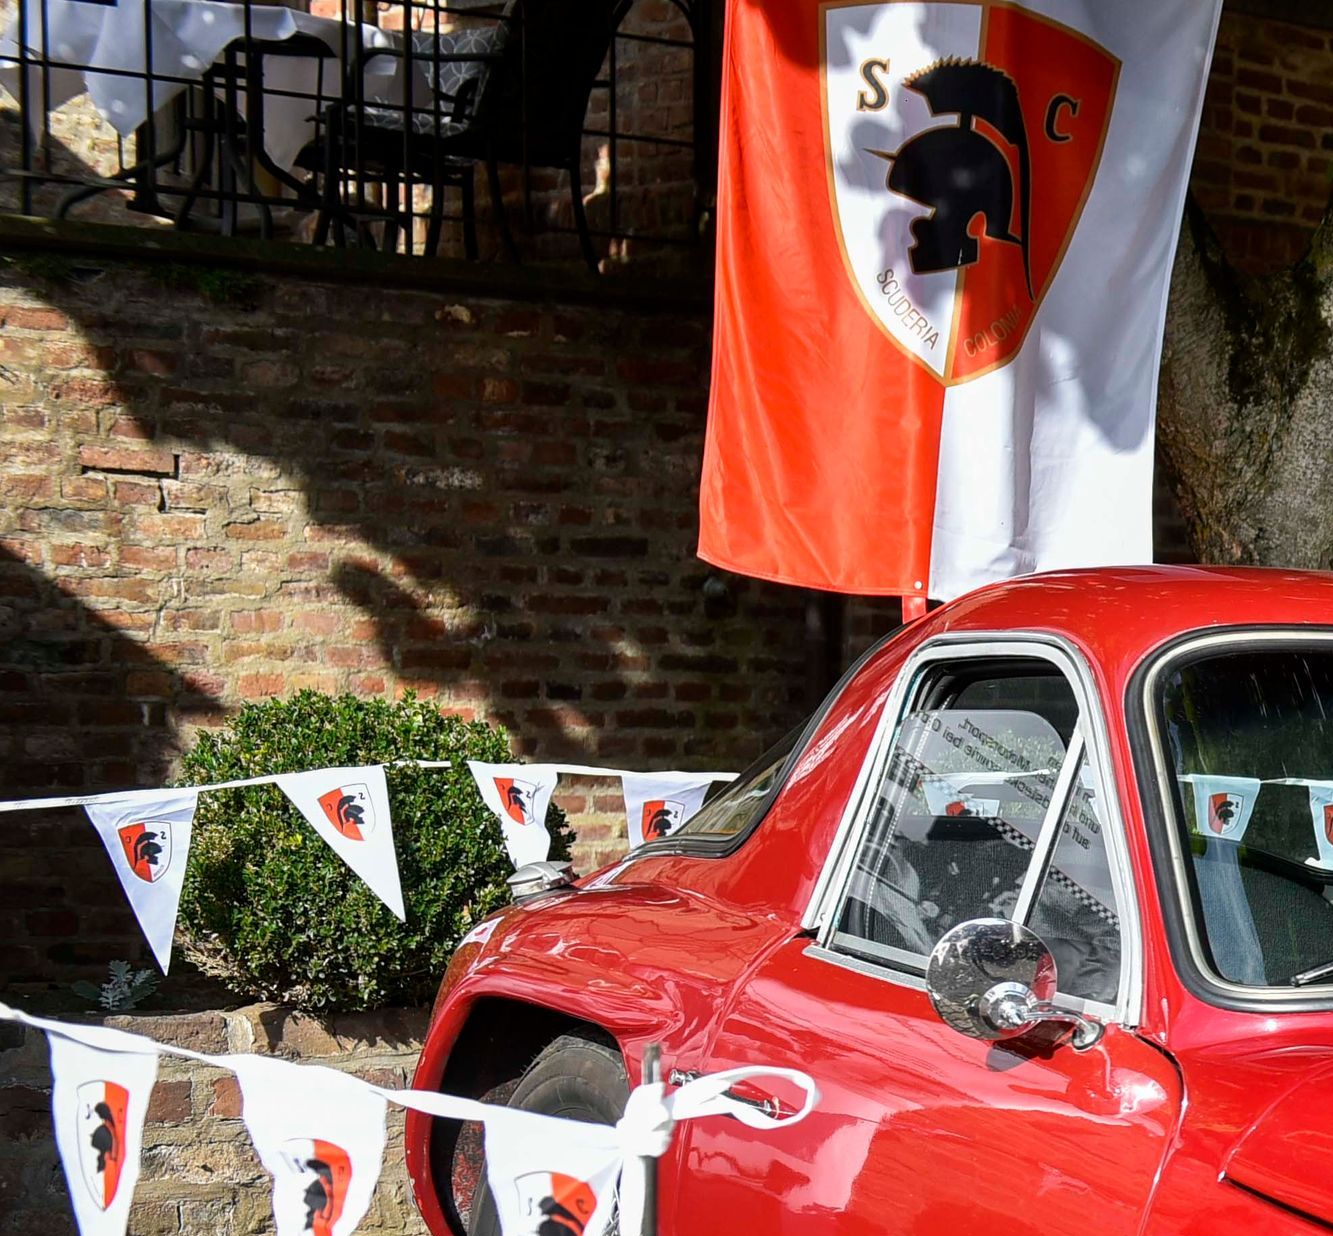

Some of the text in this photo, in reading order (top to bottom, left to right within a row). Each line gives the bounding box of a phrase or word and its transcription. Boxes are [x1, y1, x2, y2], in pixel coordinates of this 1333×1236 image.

[856, 57, 1082, 144] S C
[876, 268, 940, 350] SCUDERIA
